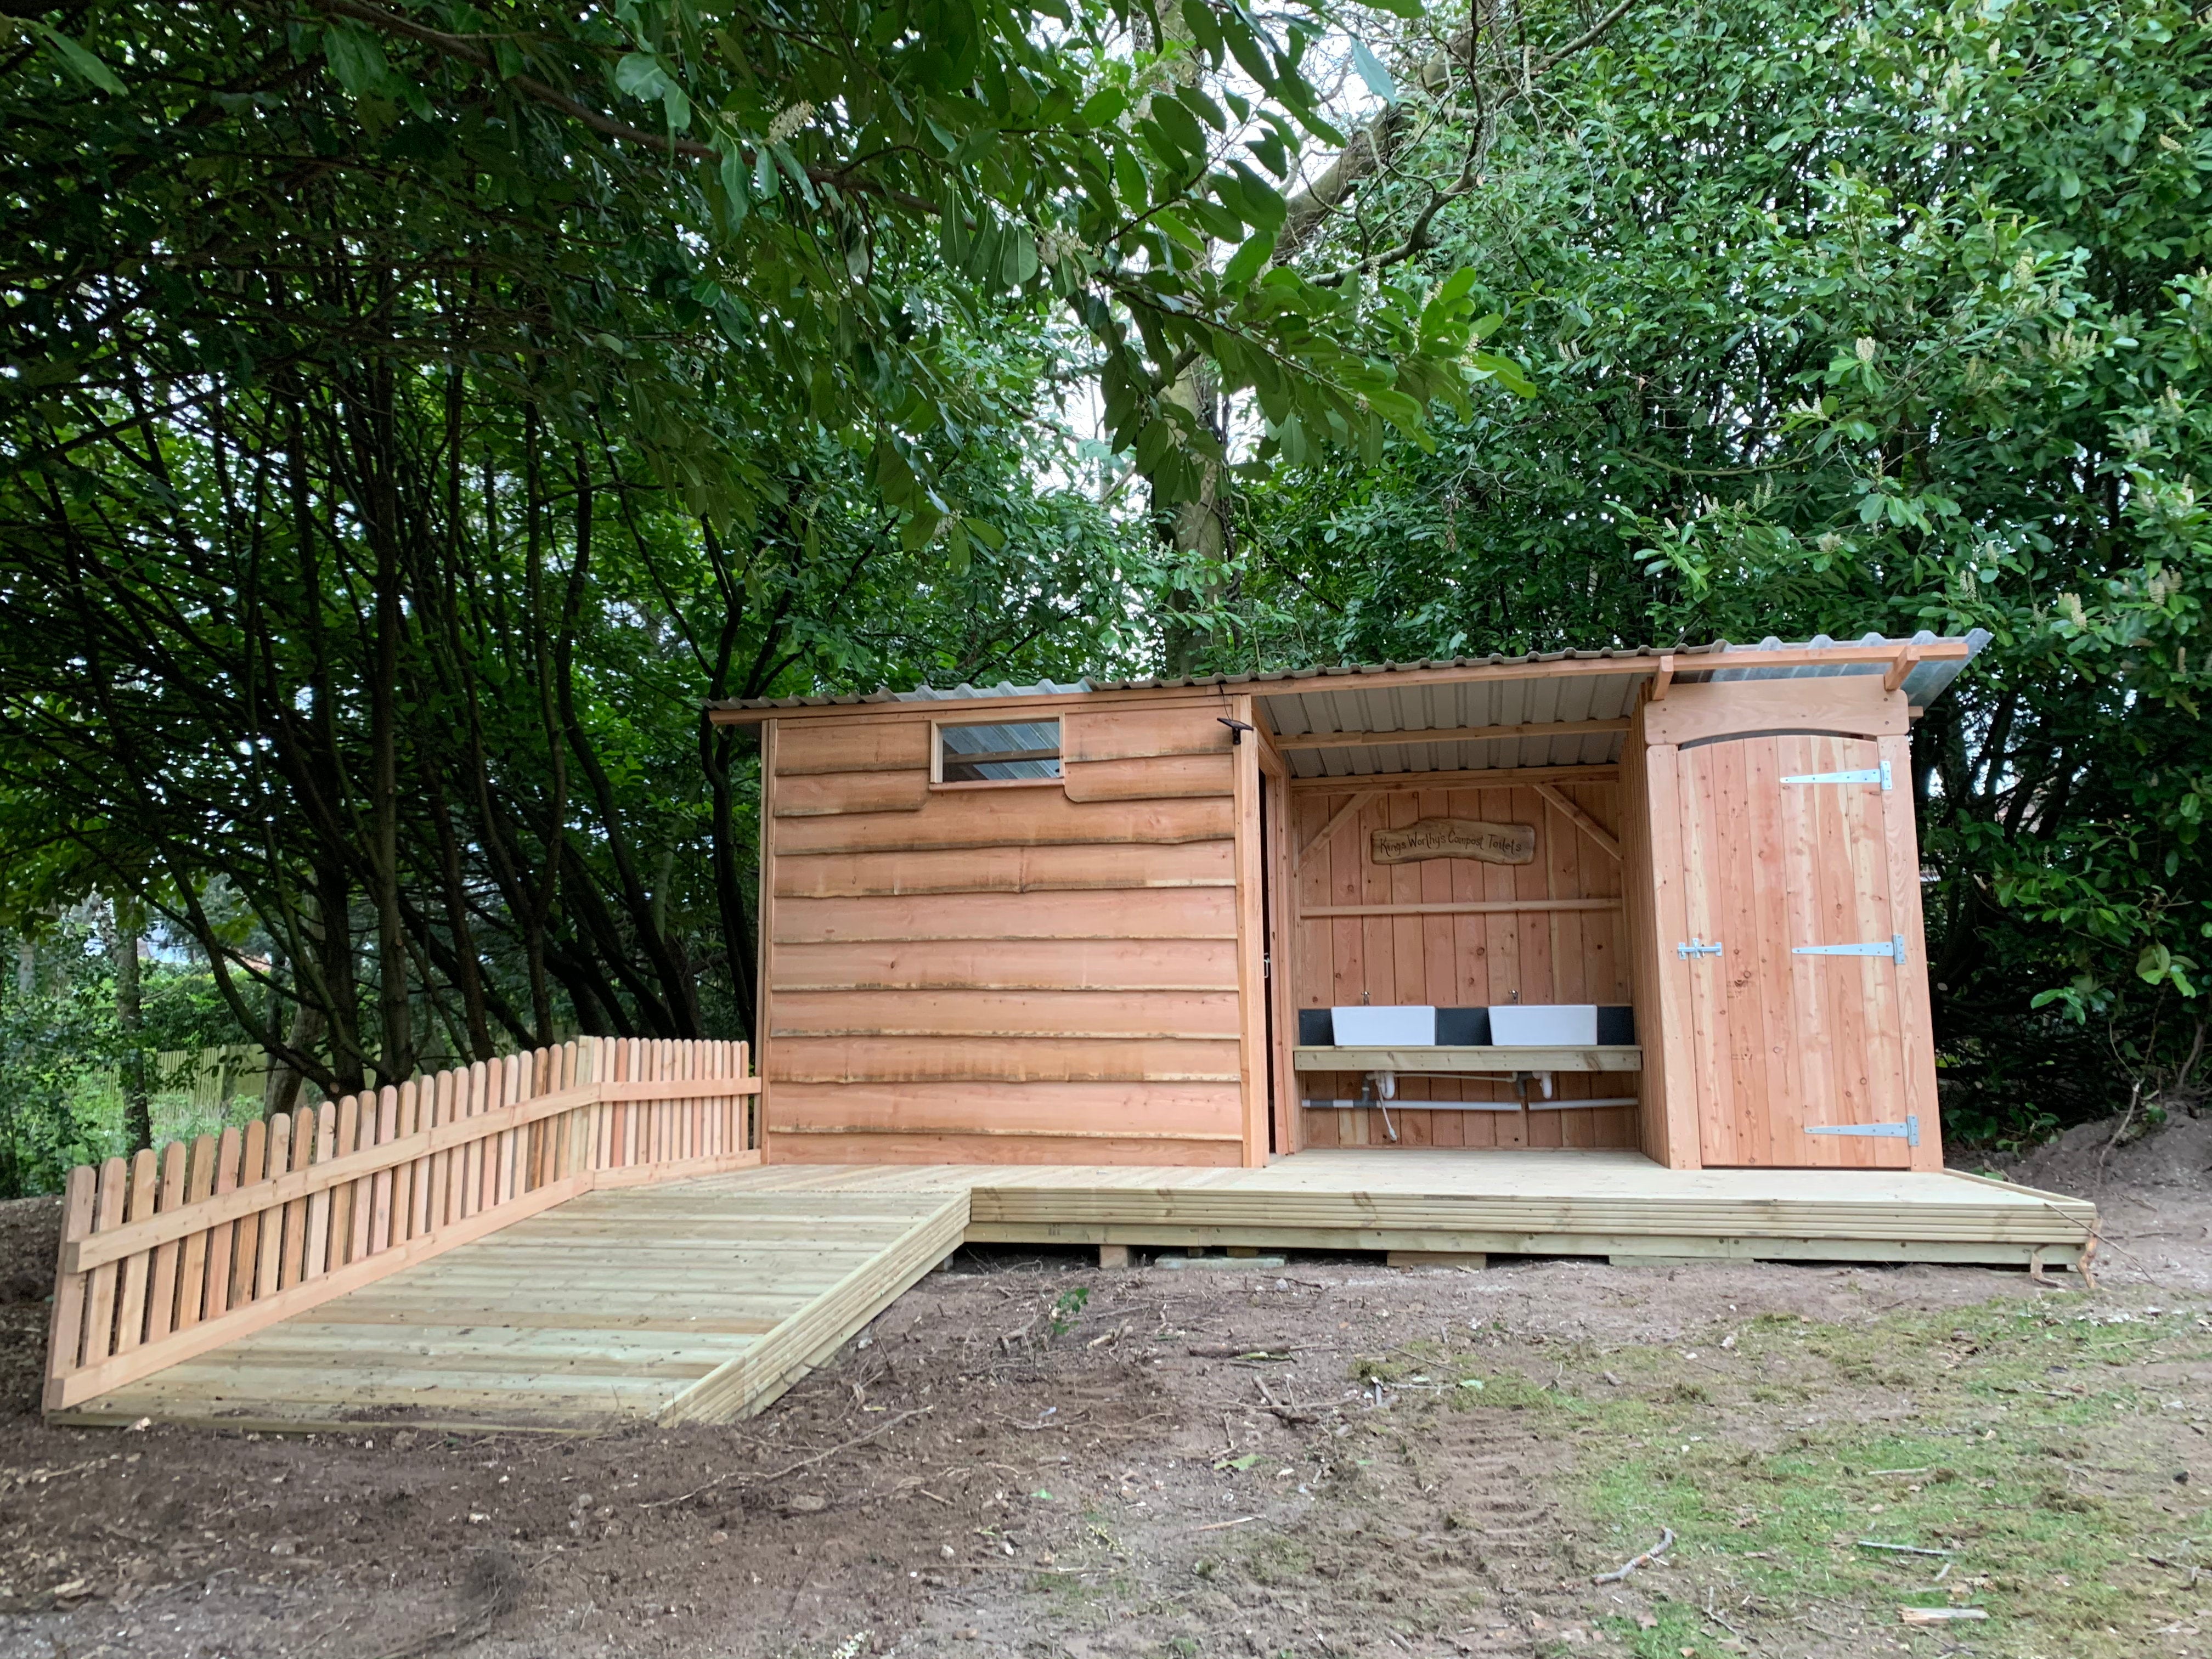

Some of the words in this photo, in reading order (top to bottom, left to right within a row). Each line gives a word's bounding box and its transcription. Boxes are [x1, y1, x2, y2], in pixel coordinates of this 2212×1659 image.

[1380, 837, 1407, 857] Kings
[1407, 832, 1446, 849] Worthy's
[1448, 830, 1484, 850] Compost
[1488, 833, 1522, 854] Toilets
